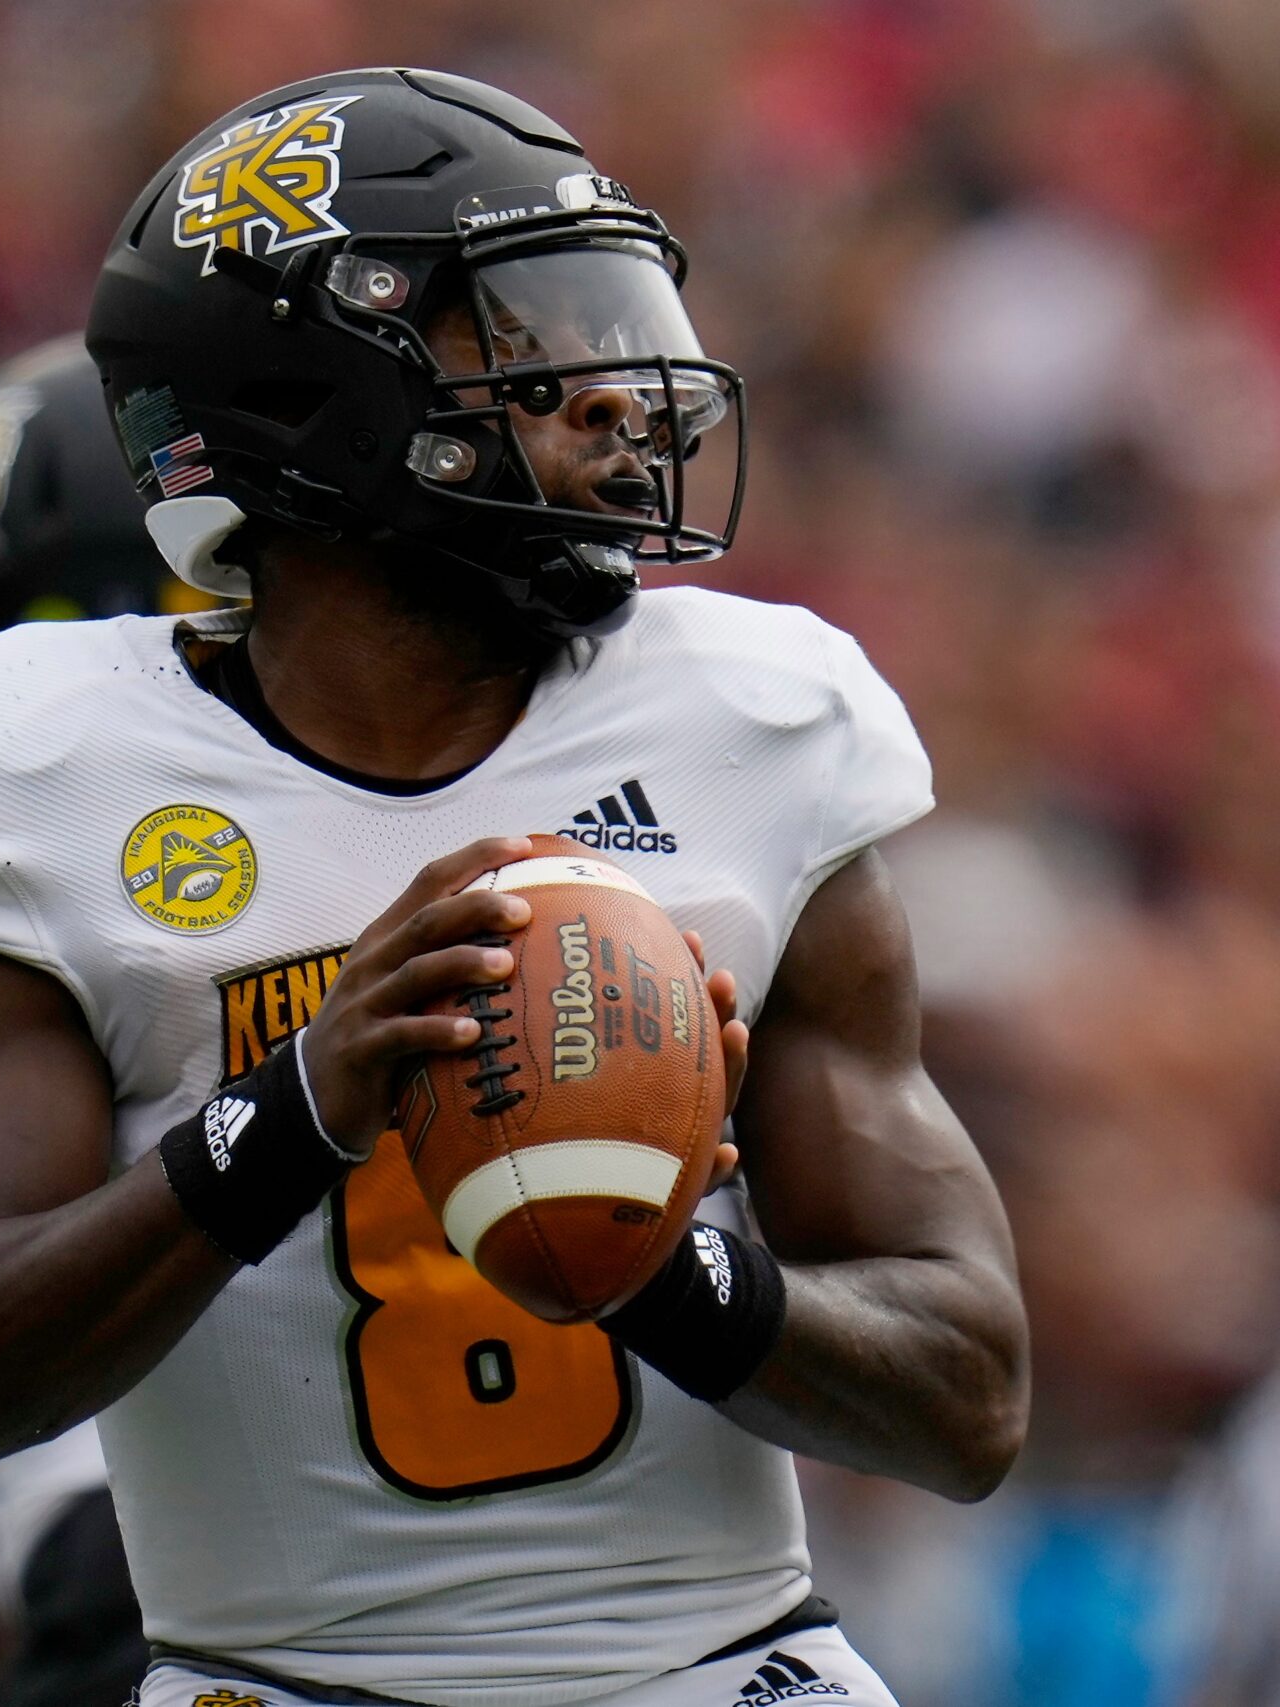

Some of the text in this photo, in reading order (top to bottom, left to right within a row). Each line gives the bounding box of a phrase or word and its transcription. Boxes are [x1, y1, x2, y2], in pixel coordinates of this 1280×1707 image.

[129, 809, 208, 858] INAUGURAL
[130, 827, 237, 889] 20 22
[144, 848, 252, 927] FOOTBALL SEASON
[552, 914, 596, 1083] Wilson
[623, 943, 662, 1055] GST
[670, 977, 689, 1045] NCAA
[204, 1099, 231, 1172] adidas
[612, 1204, 662, 1227] GST
[703, 1227, 733, 1306] adidas
[326, 1130, 638, 1504] 8
